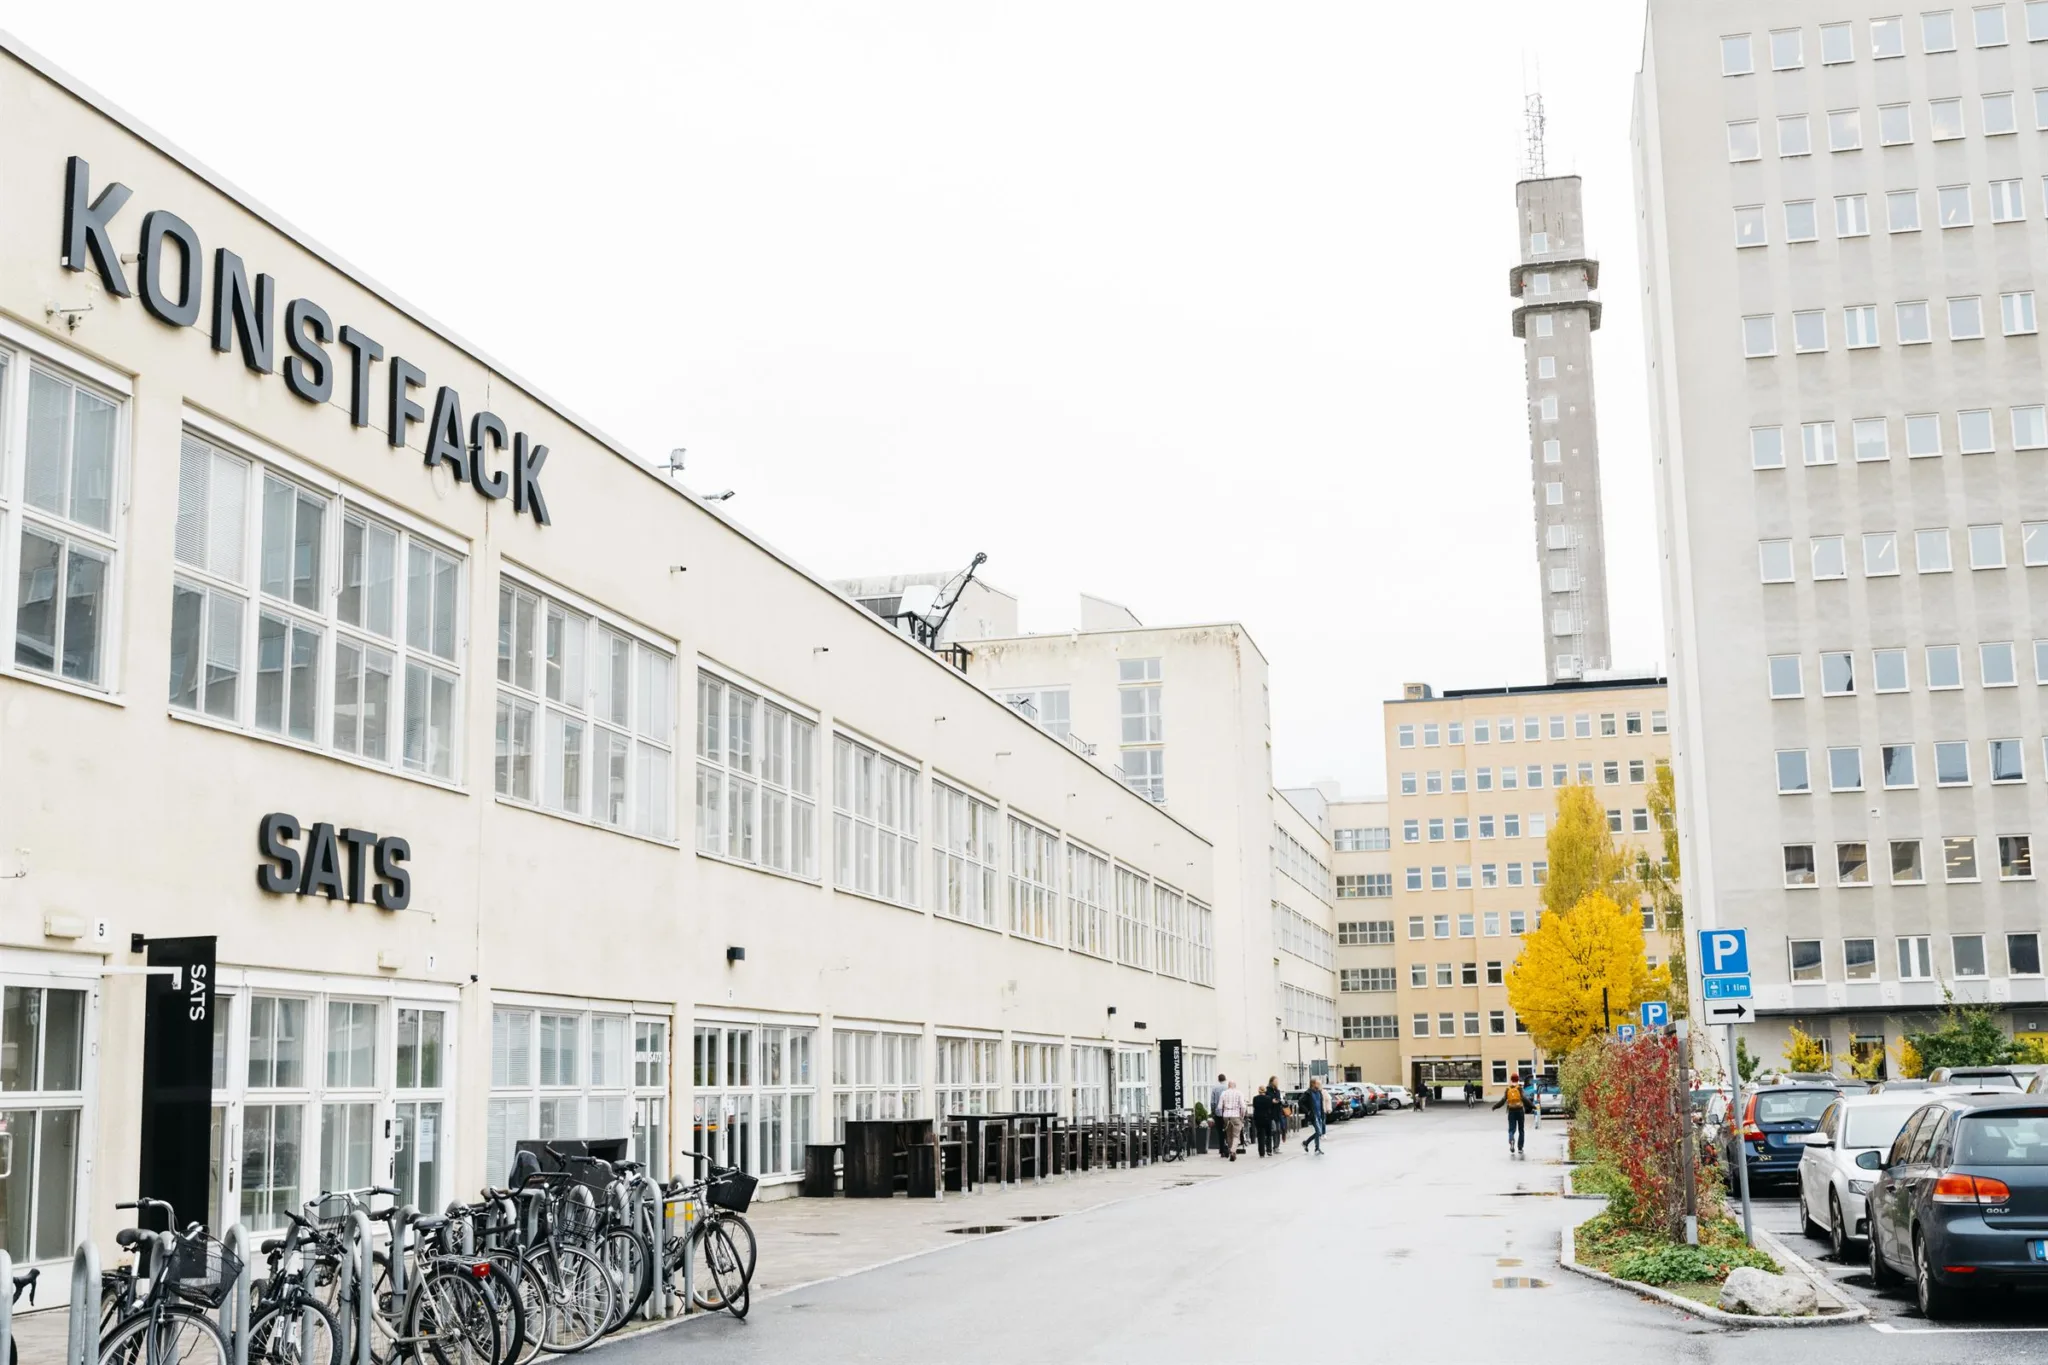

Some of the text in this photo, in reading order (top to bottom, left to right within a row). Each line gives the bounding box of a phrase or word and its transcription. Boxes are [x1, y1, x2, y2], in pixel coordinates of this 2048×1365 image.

[62, 156, 551, 526] KONSTFACK
[258, 812, 411, 911] SATS
[98, 923, 105, 936] 5
[1712, 934, 1739, 970] P
[189, 964, 207, 1021] SATS
[1733, 983, 1747, 991] tim
[1648, 1004, 1663, 1025] P
[1622, 1026, 1633, 1041] P
[1173, 1046, 1181, 1090] RESTAURANG
